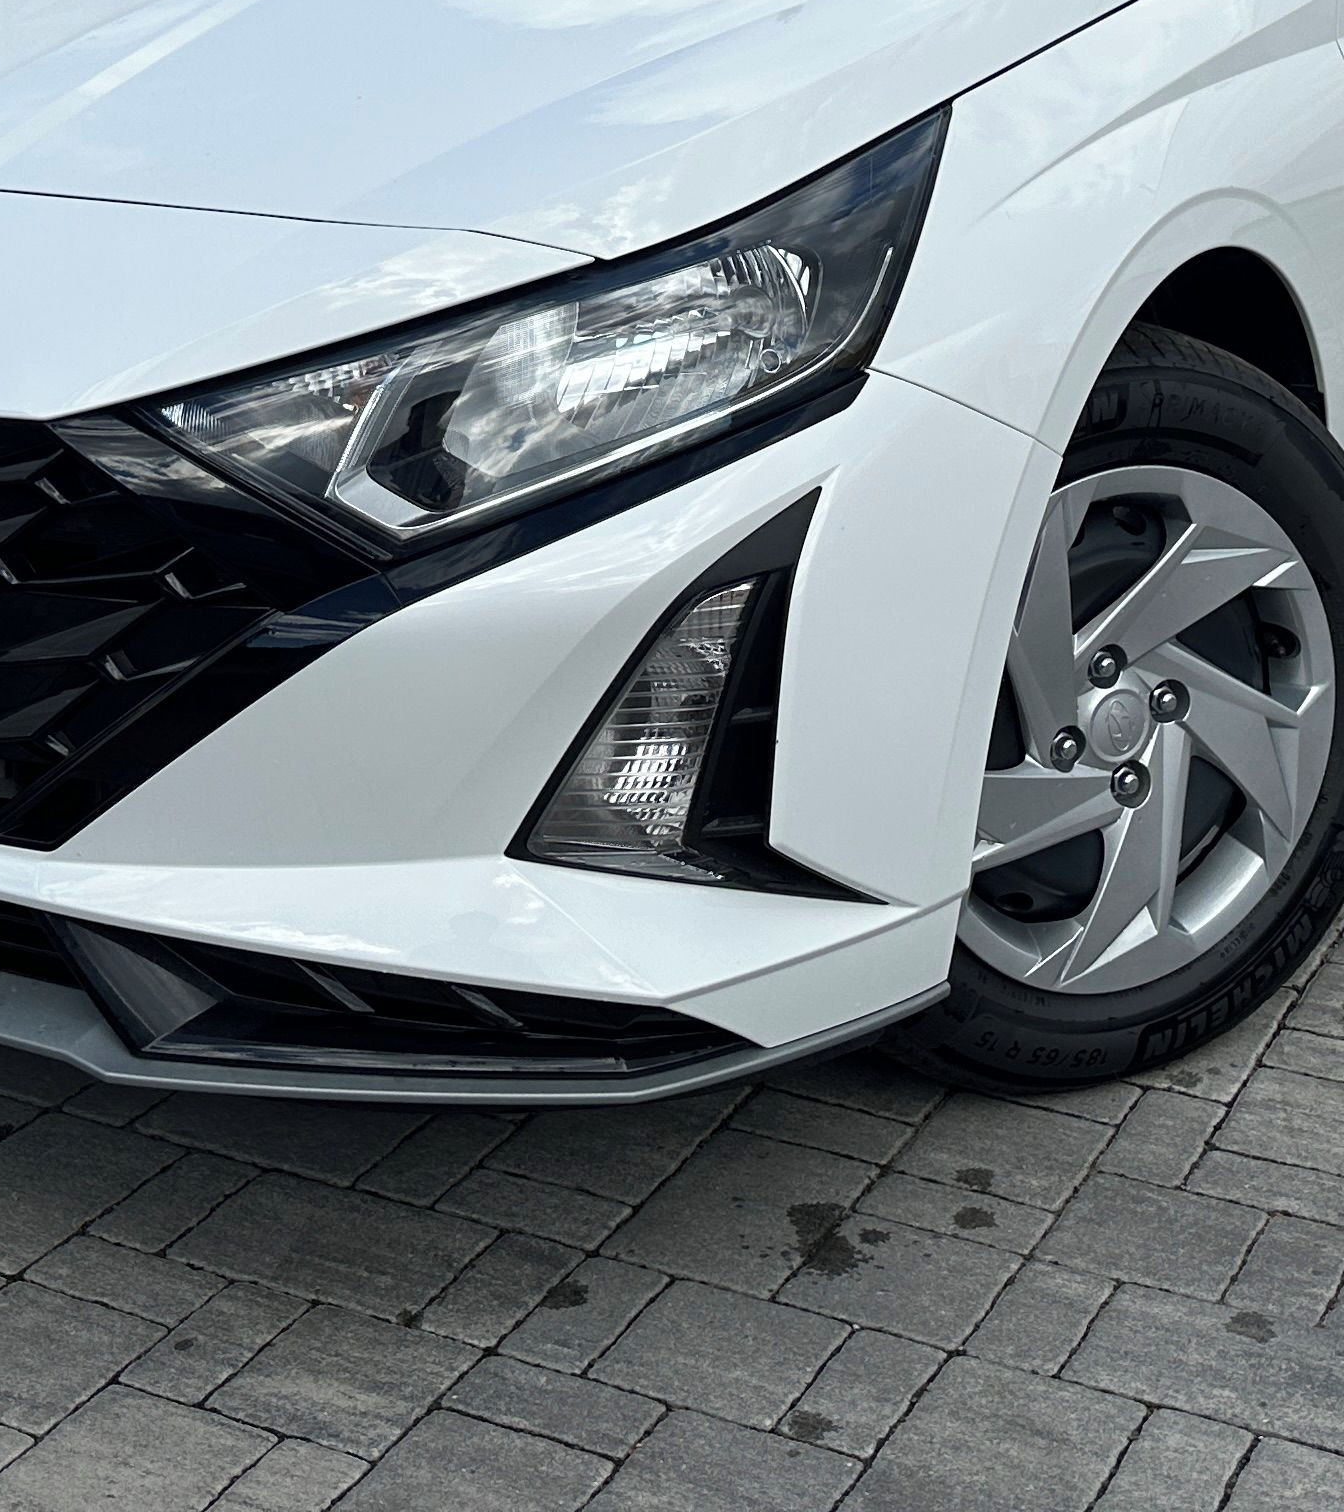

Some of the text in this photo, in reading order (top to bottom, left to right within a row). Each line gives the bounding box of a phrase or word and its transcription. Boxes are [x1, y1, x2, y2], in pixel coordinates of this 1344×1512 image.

[1143, 913, 1316, 1060] MICHELIN
[971, 1030, 1109, 1069] 185/65 R 15
